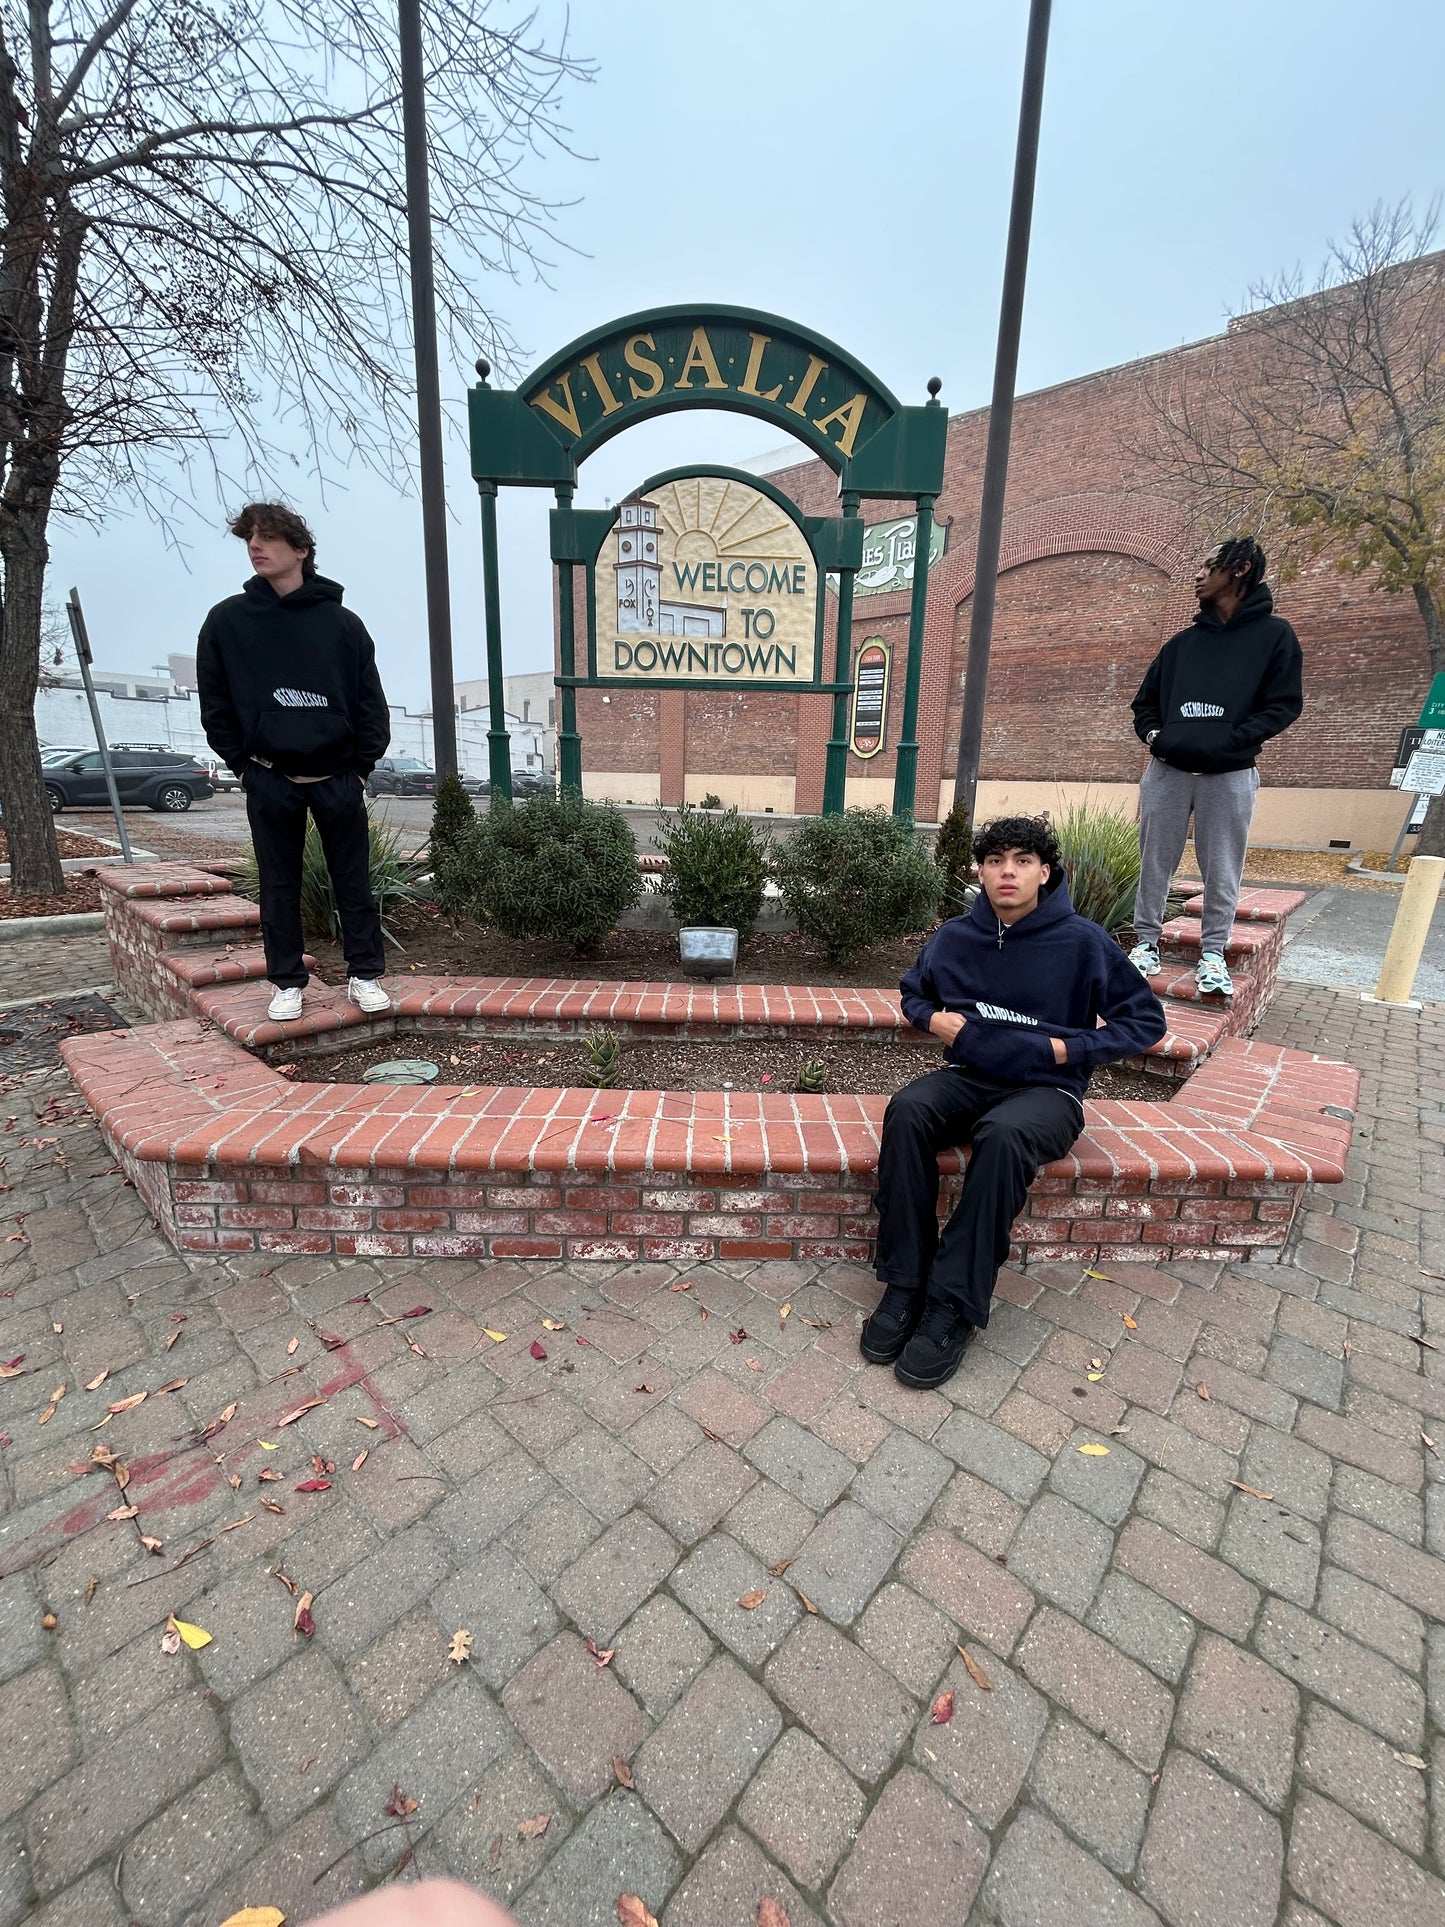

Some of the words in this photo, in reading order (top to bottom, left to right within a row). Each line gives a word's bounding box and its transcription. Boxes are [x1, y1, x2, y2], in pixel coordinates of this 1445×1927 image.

[672, 561, 806, 594] WELCOME
[619, 599, 636, 609] FOX
[646, 599, 655, 627] FOX
[741, 608, 775, 639] TO
[615, 640, 797, 675] DOWNTOWN
[1180, 701, 1225, 718] BEENBLESSED
